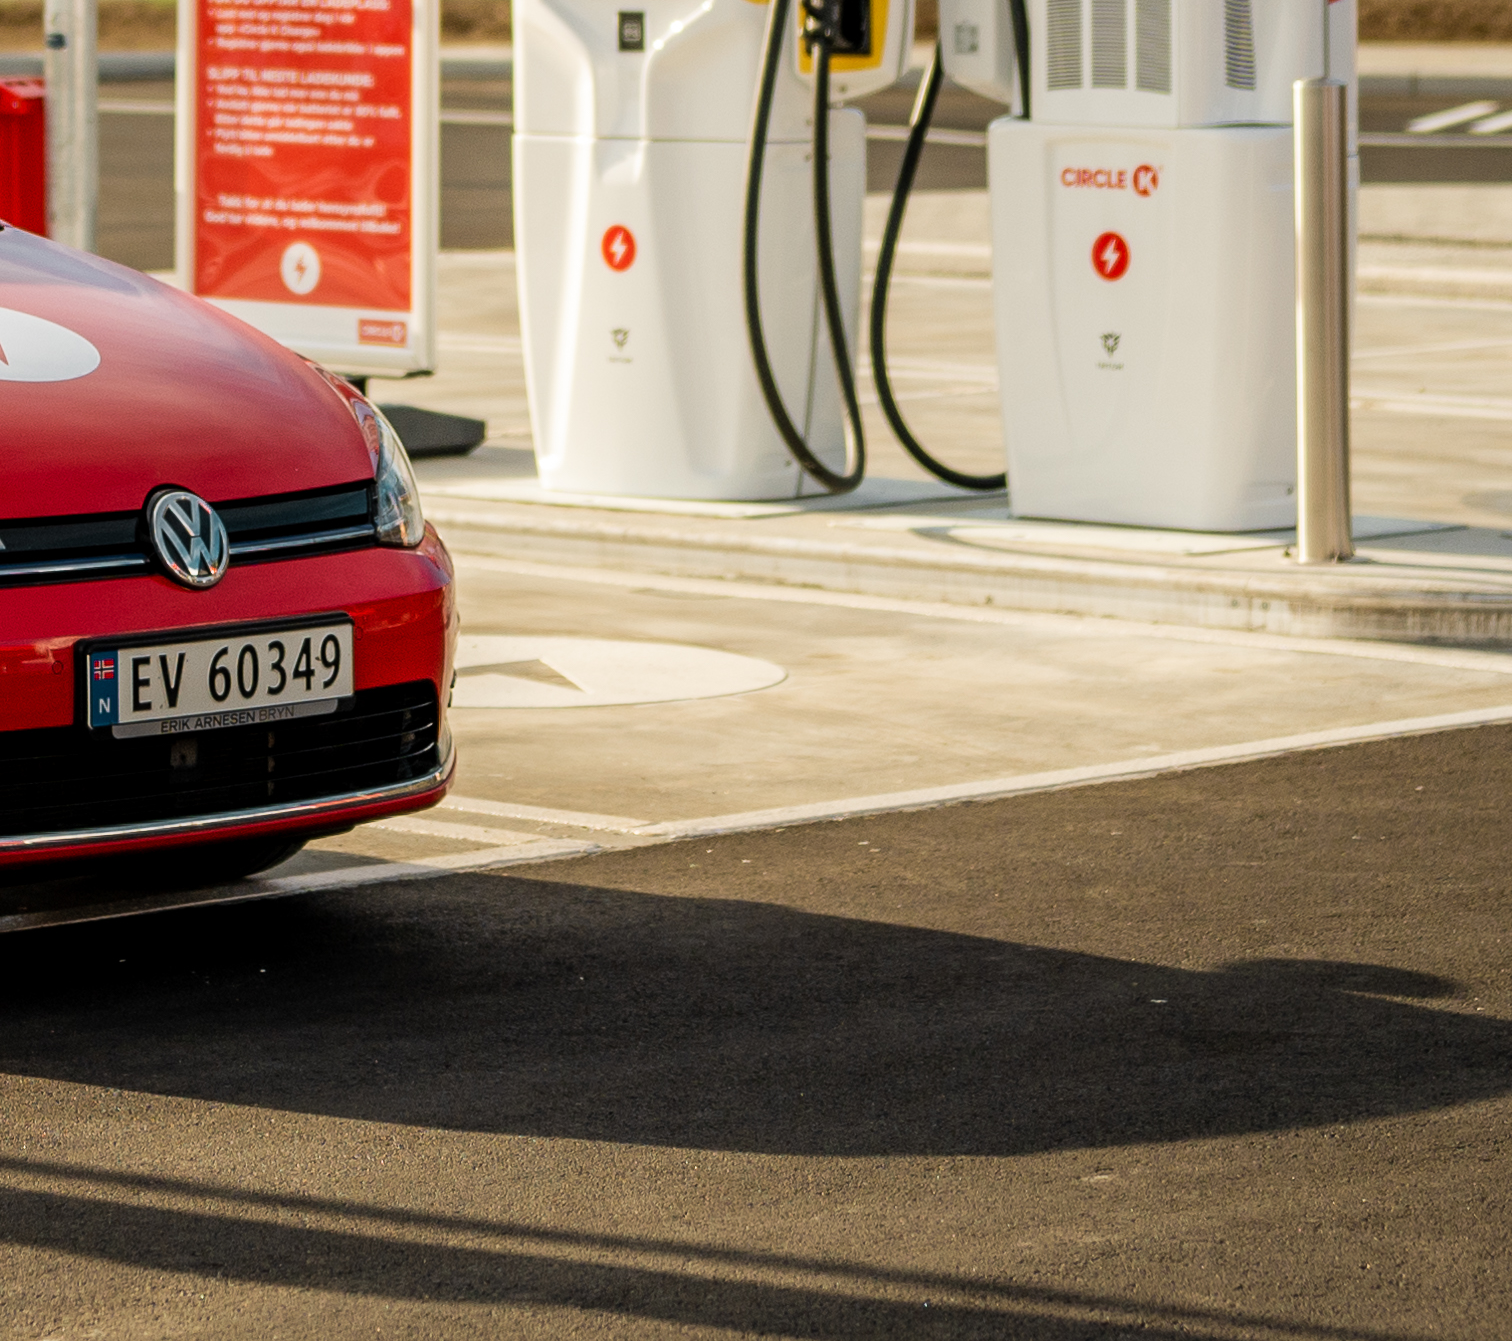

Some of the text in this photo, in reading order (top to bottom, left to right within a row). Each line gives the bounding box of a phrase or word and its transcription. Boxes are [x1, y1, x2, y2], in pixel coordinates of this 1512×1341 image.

[1061, 167, 1127, 189] CIRCLE
[132, 633, 341, 712] EV 60349
[98, 697, 111, 715] N
[160, 705, 295, 734] ERIK ARNESEN BRYN
